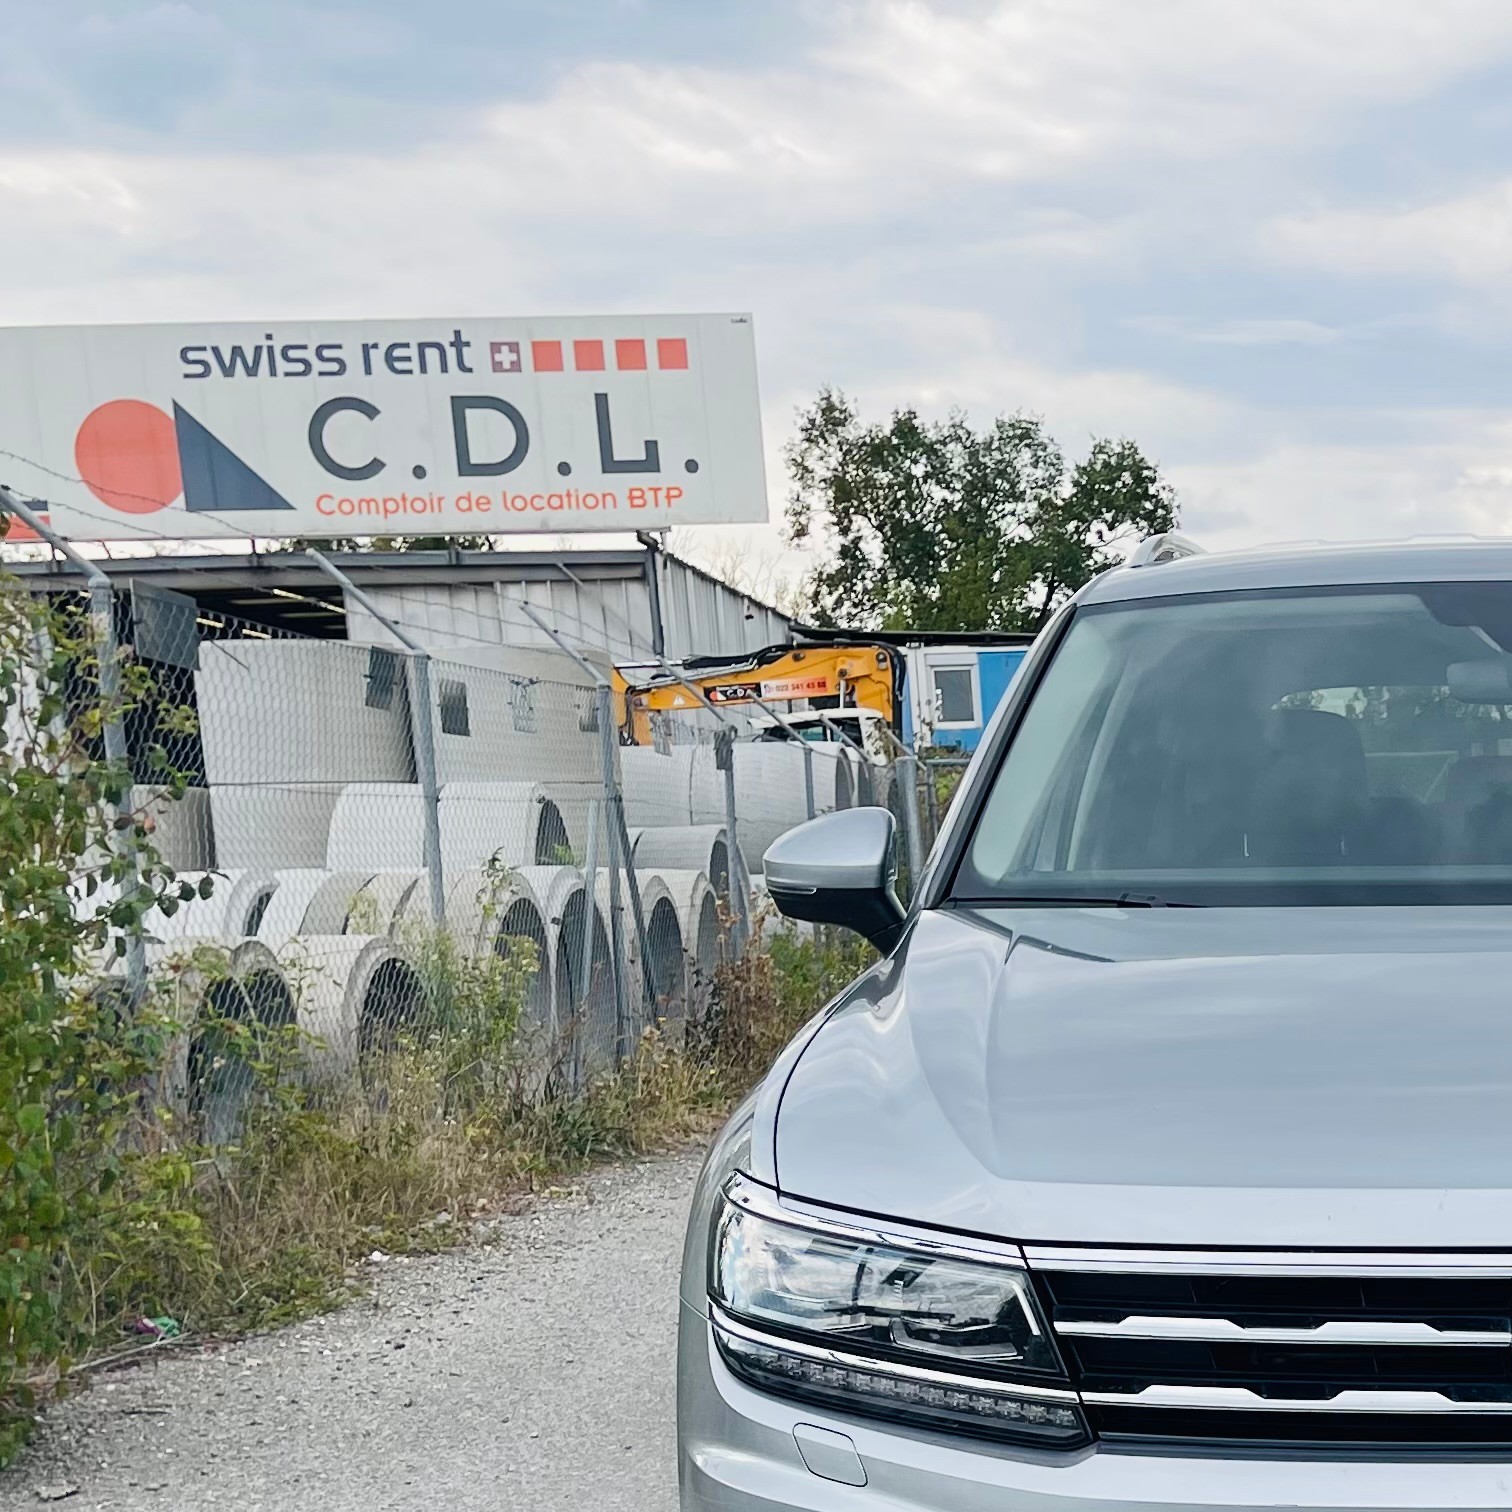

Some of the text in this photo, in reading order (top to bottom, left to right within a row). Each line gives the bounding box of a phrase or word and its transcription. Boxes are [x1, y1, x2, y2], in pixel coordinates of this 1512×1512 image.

[180, 329, 474, 379] swiss rent
[315, 486, 683, 519] Comptoir de location BTP
